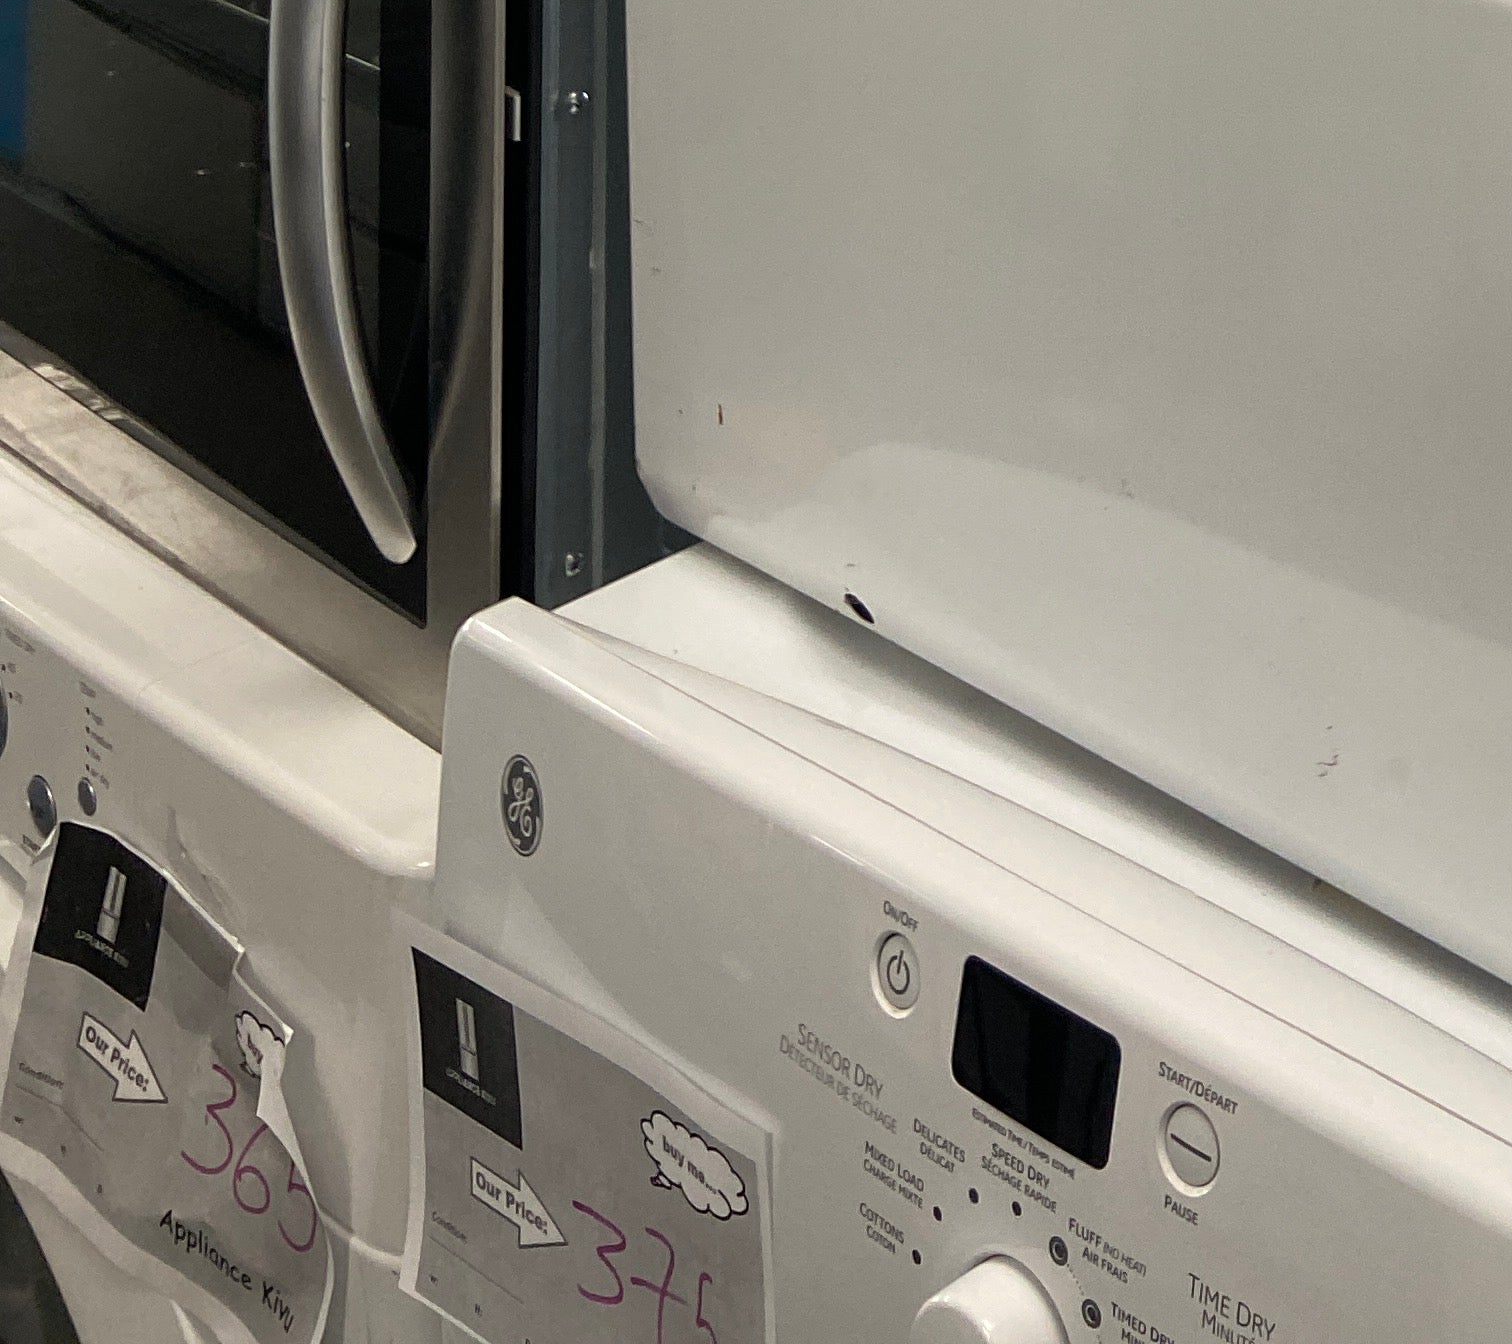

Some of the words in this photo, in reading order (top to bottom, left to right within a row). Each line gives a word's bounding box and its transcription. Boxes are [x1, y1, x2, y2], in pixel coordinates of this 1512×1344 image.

[85, 1024, 109, 1056] Our
[110, 1046, 151, 1093] Price:
[798, 1023, 850, 1080] SENSOR
[854, 1063, 883, 1100] DRY
[181, 1063, 318, 1253] 365
[662, 1134, 685, 1168] buy
[914, 1118, 966, 1163] DELICATES
[863, 1158, 897, 1192] CHARGE
[864, 1140, 896, 1172] MIXED
[897, 1163, 925, 1192] LOAD
[991, 1142, 1025, 1174] SPEED
[1027, 1165, 1050, 1190] DRY
[475, 1171, 503, 1204] Our
[505, 1188, 548, 1236] Price:
[1024, 1184, 1057, 1214] RAPIDE
[1164, 1194, 1199, 1226] PAUSE
[859, 1202, 905, 1244] COTTONS
[866, 1225, 897, 1255] COTON
[1068, 1217, 1102, 1248] FLUFF
[159, 1209, 253, 1291] Appliance
[1082, 1246, 1100, 1268] AIR
[1101, 1258, 1128, 1284] FRAIS
[1110, 1301, 1147, 1335] TIMED
[1188, 1272, 1232, 1319] TIME
[1236, 1301, 1277, 1343] DRY
